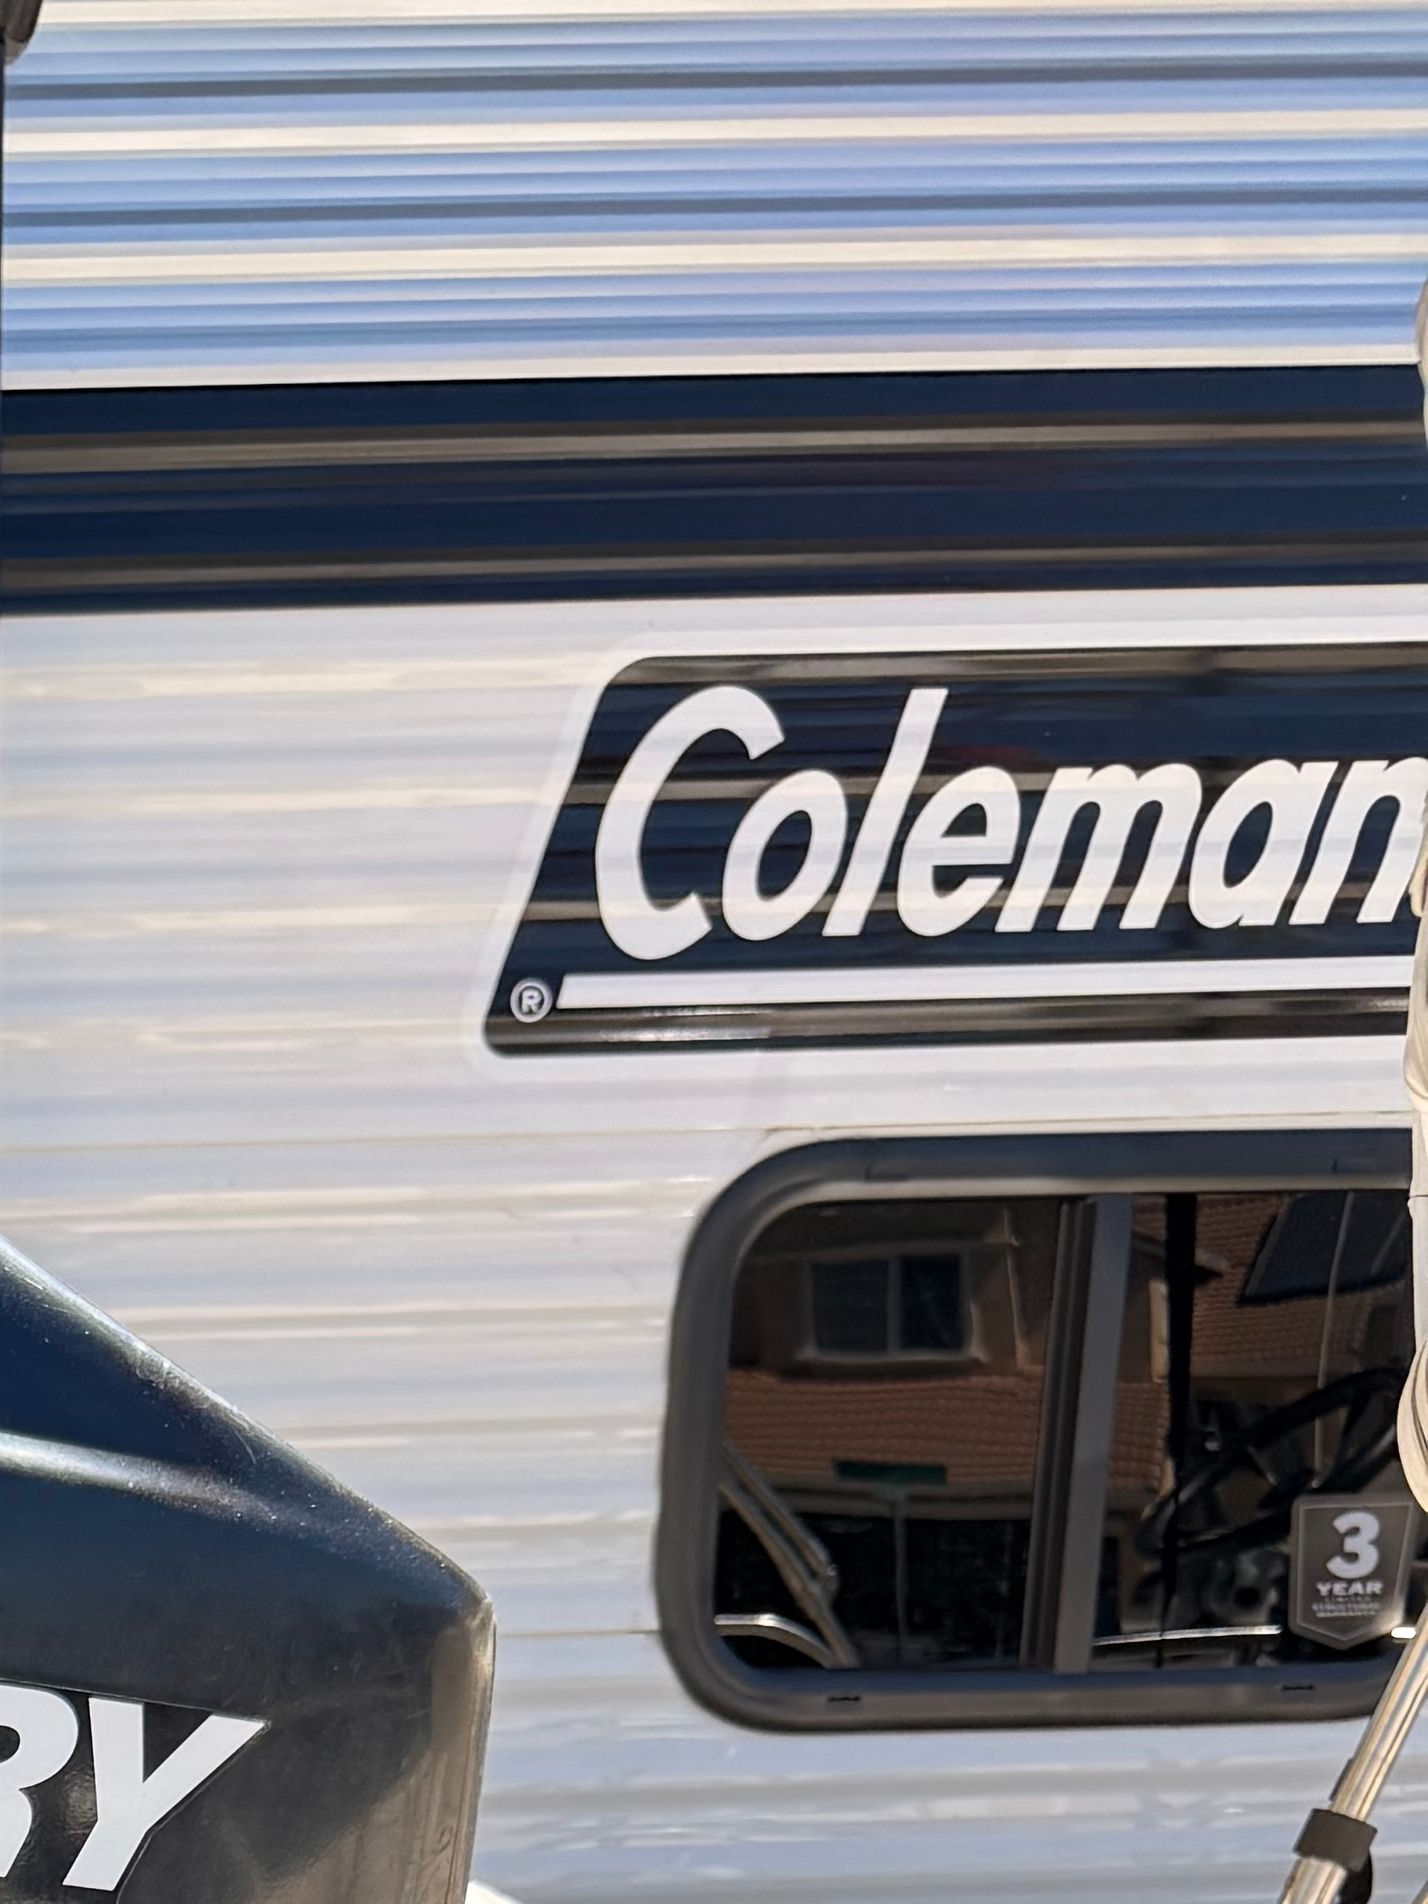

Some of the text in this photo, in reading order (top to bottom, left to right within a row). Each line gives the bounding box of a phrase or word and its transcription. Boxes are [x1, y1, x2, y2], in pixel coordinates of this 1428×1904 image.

[595, 685, 1425, 960] Coleman
[1326, 1511, 1380, 1579] 3
[1315, 1580, 1384, 1596] YEAR
